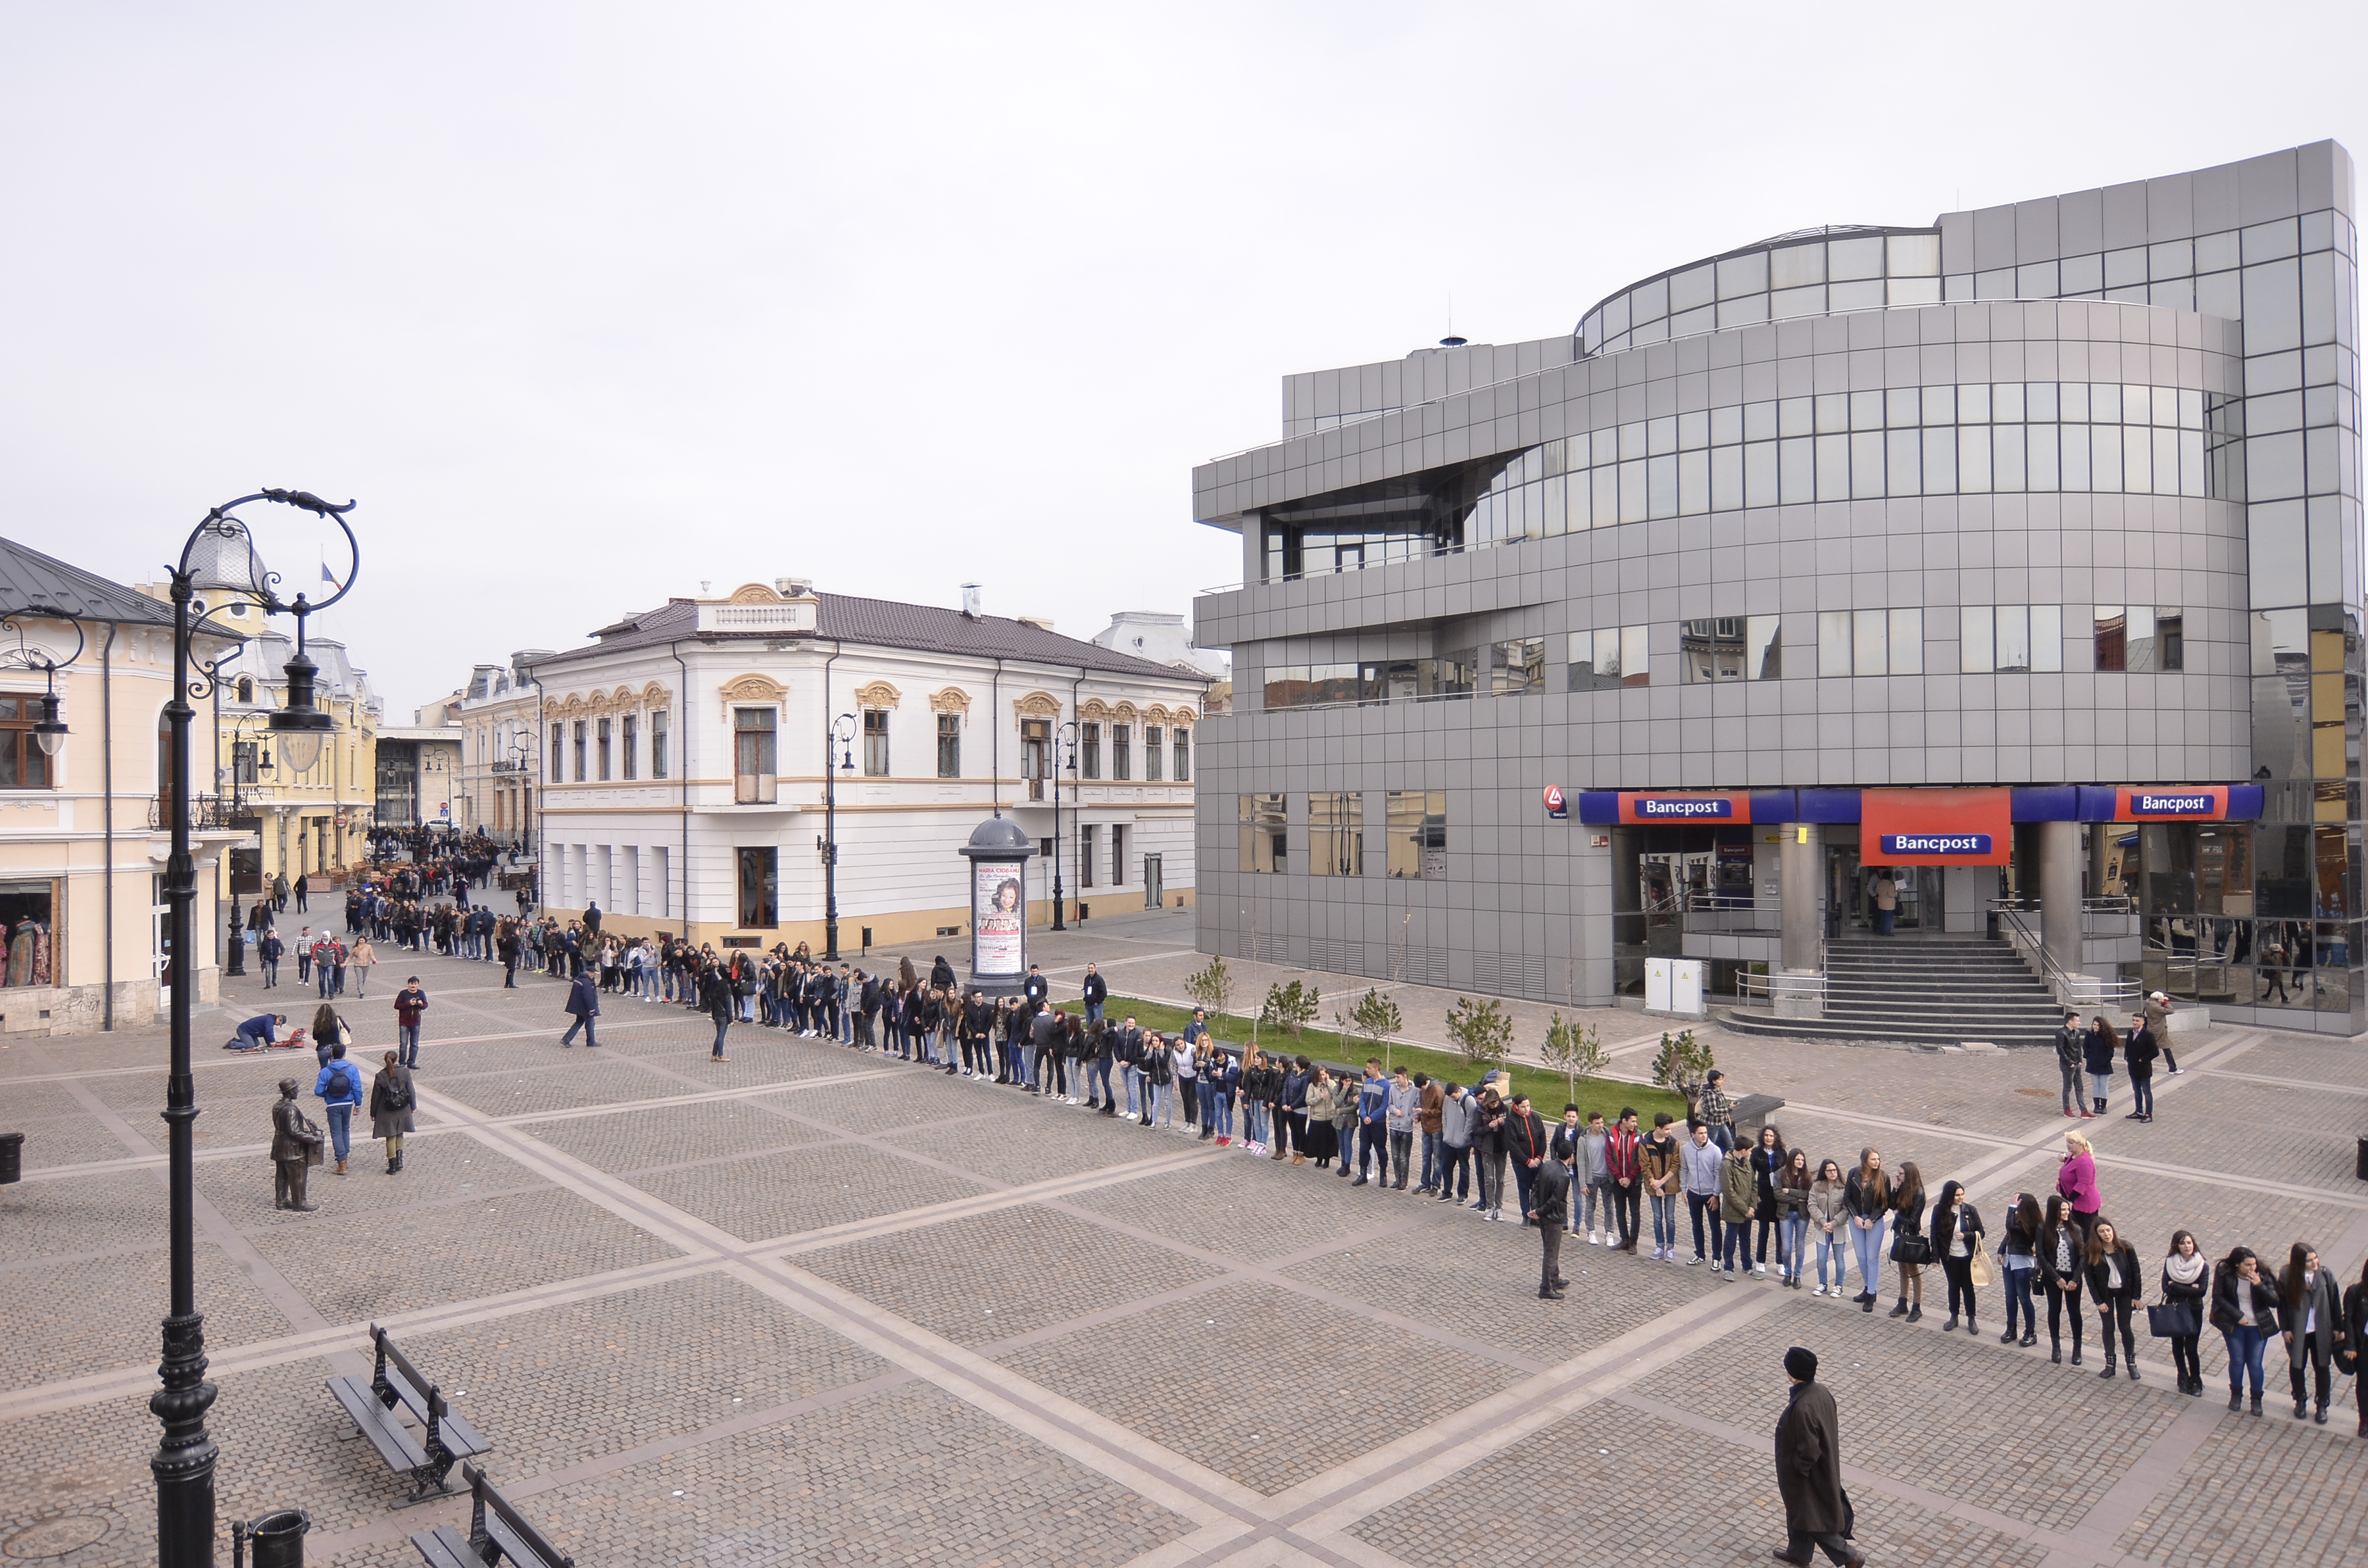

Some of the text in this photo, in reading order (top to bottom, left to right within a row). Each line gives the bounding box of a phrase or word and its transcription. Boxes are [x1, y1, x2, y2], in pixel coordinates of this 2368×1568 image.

[1646, 800, 1718, 816] Bancpost
[2142, 796, 2205, 813] Bancpost
[1896, 836, 1977, 853] Bancpost
